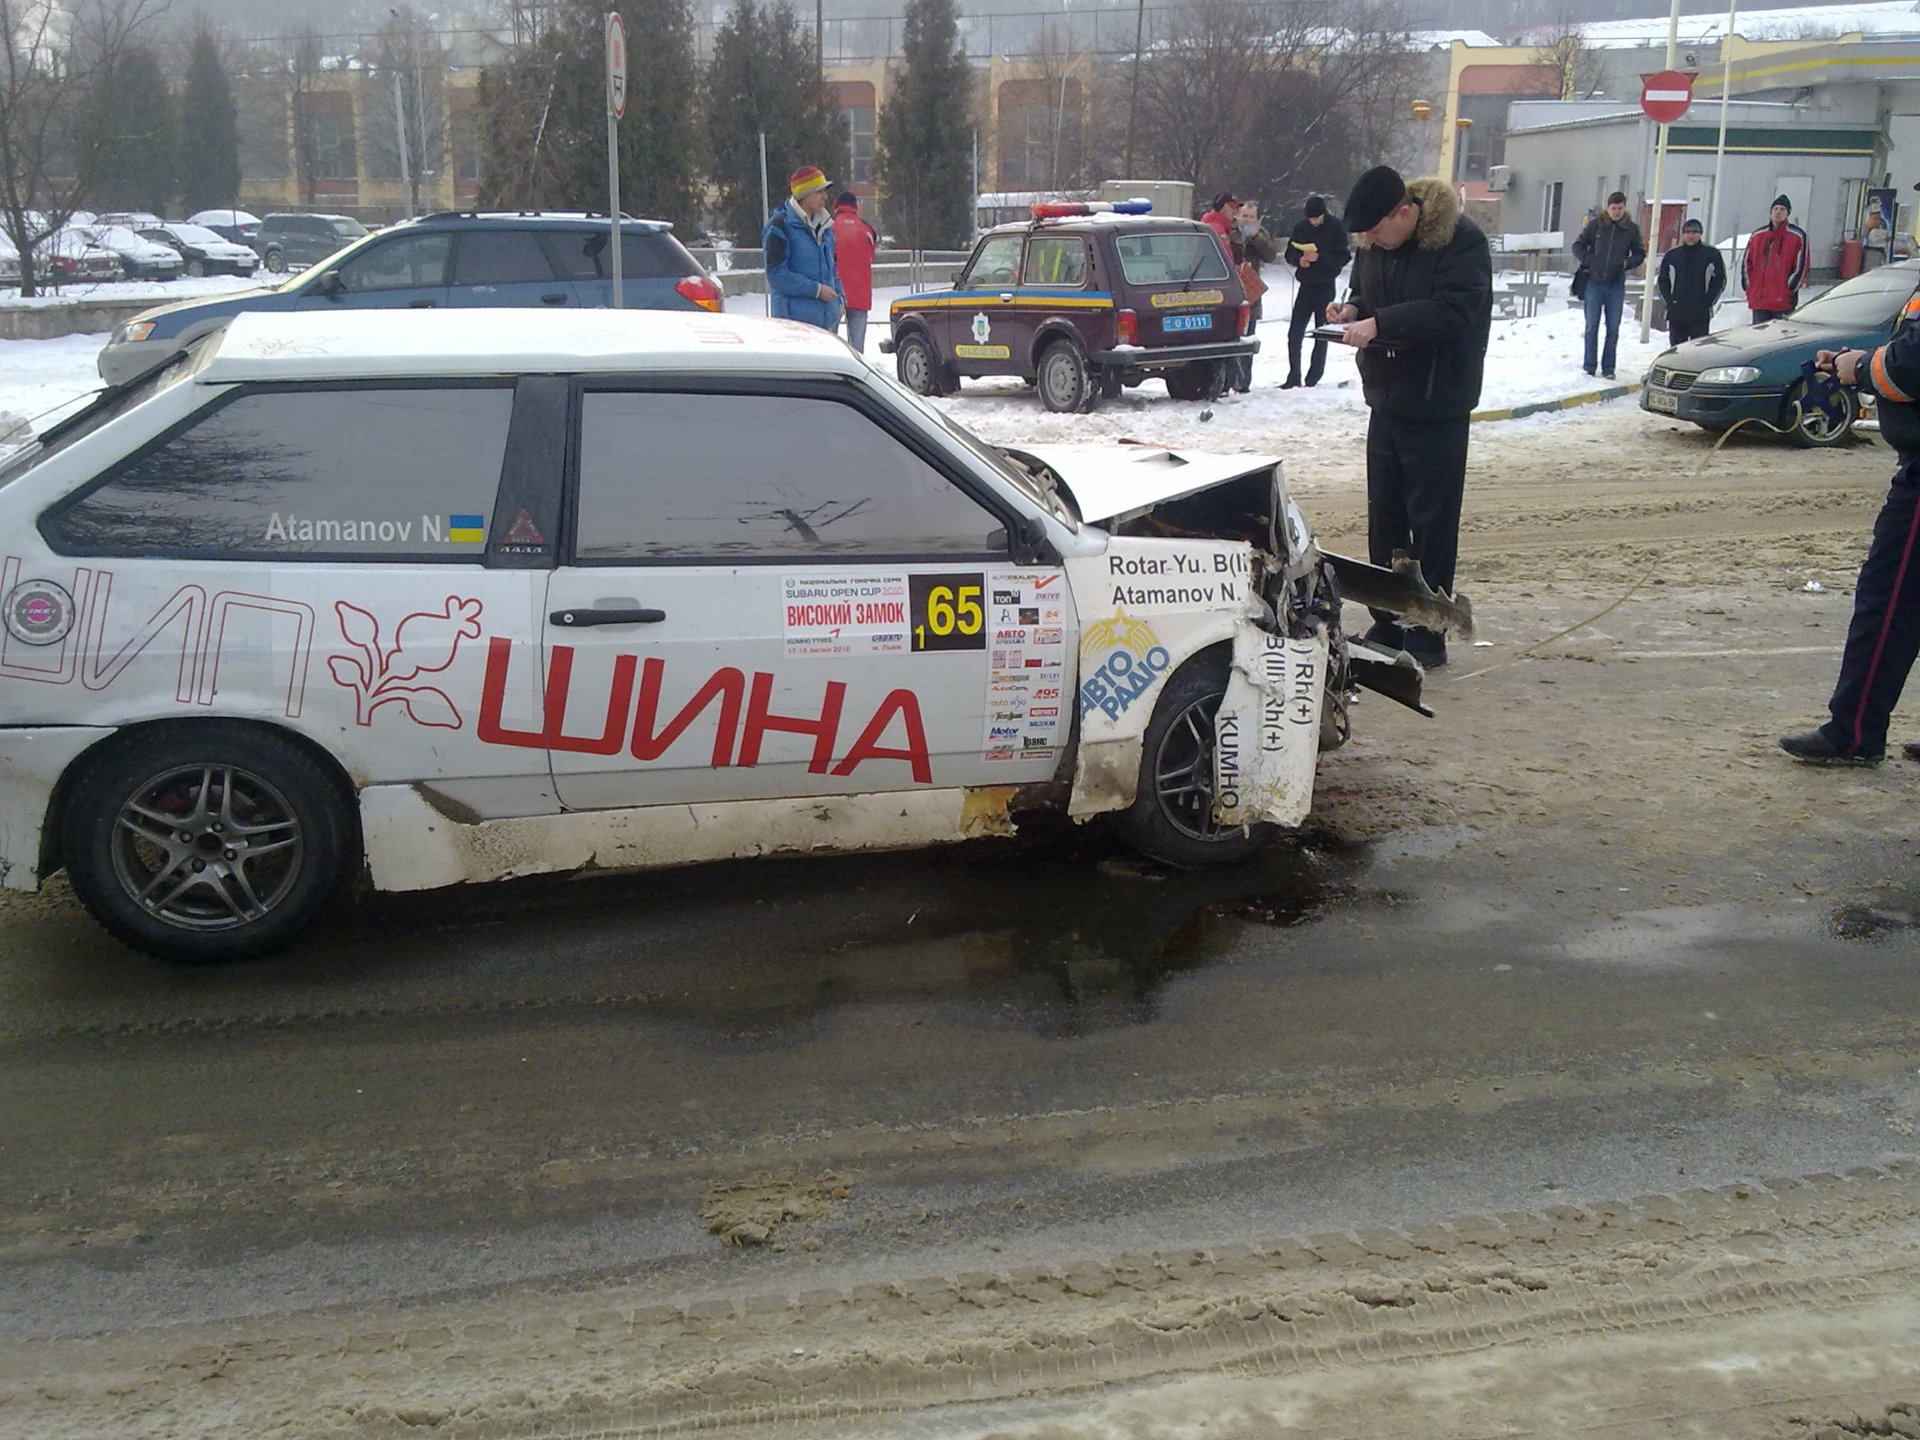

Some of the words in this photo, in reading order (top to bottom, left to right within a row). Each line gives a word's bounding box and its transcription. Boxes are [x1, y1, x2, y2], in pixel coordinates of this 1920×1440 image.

[265, 512, 412, 542] Atamanov
[422, 515, 450, 543] N.
[1109, 555, 1167, 575] Rotar
[1173, 554, 1207, 573] Yu.
[786, 588, 828, 598] SUBARU
[830, 587, 858, 597] OPEN
[860, 586, 881, 596] CUP
[1112, 583, 1214, 605] Atamanov
[1221, 583, 1241, 601] N.
[787, 599, 852, 627] ВИСОКИЙ
[856, 602, 905, 625] ЗАМОК
[927, 585, 984, 637] 65
[914, 624, 926, 650] 1
[997, 629, 1026, 639] АВТО
[477, 636, 933, 784] ШИНА
[990, 727, 1019, 735] Motor
[1219, 715, 1239, 809] KUMHO
